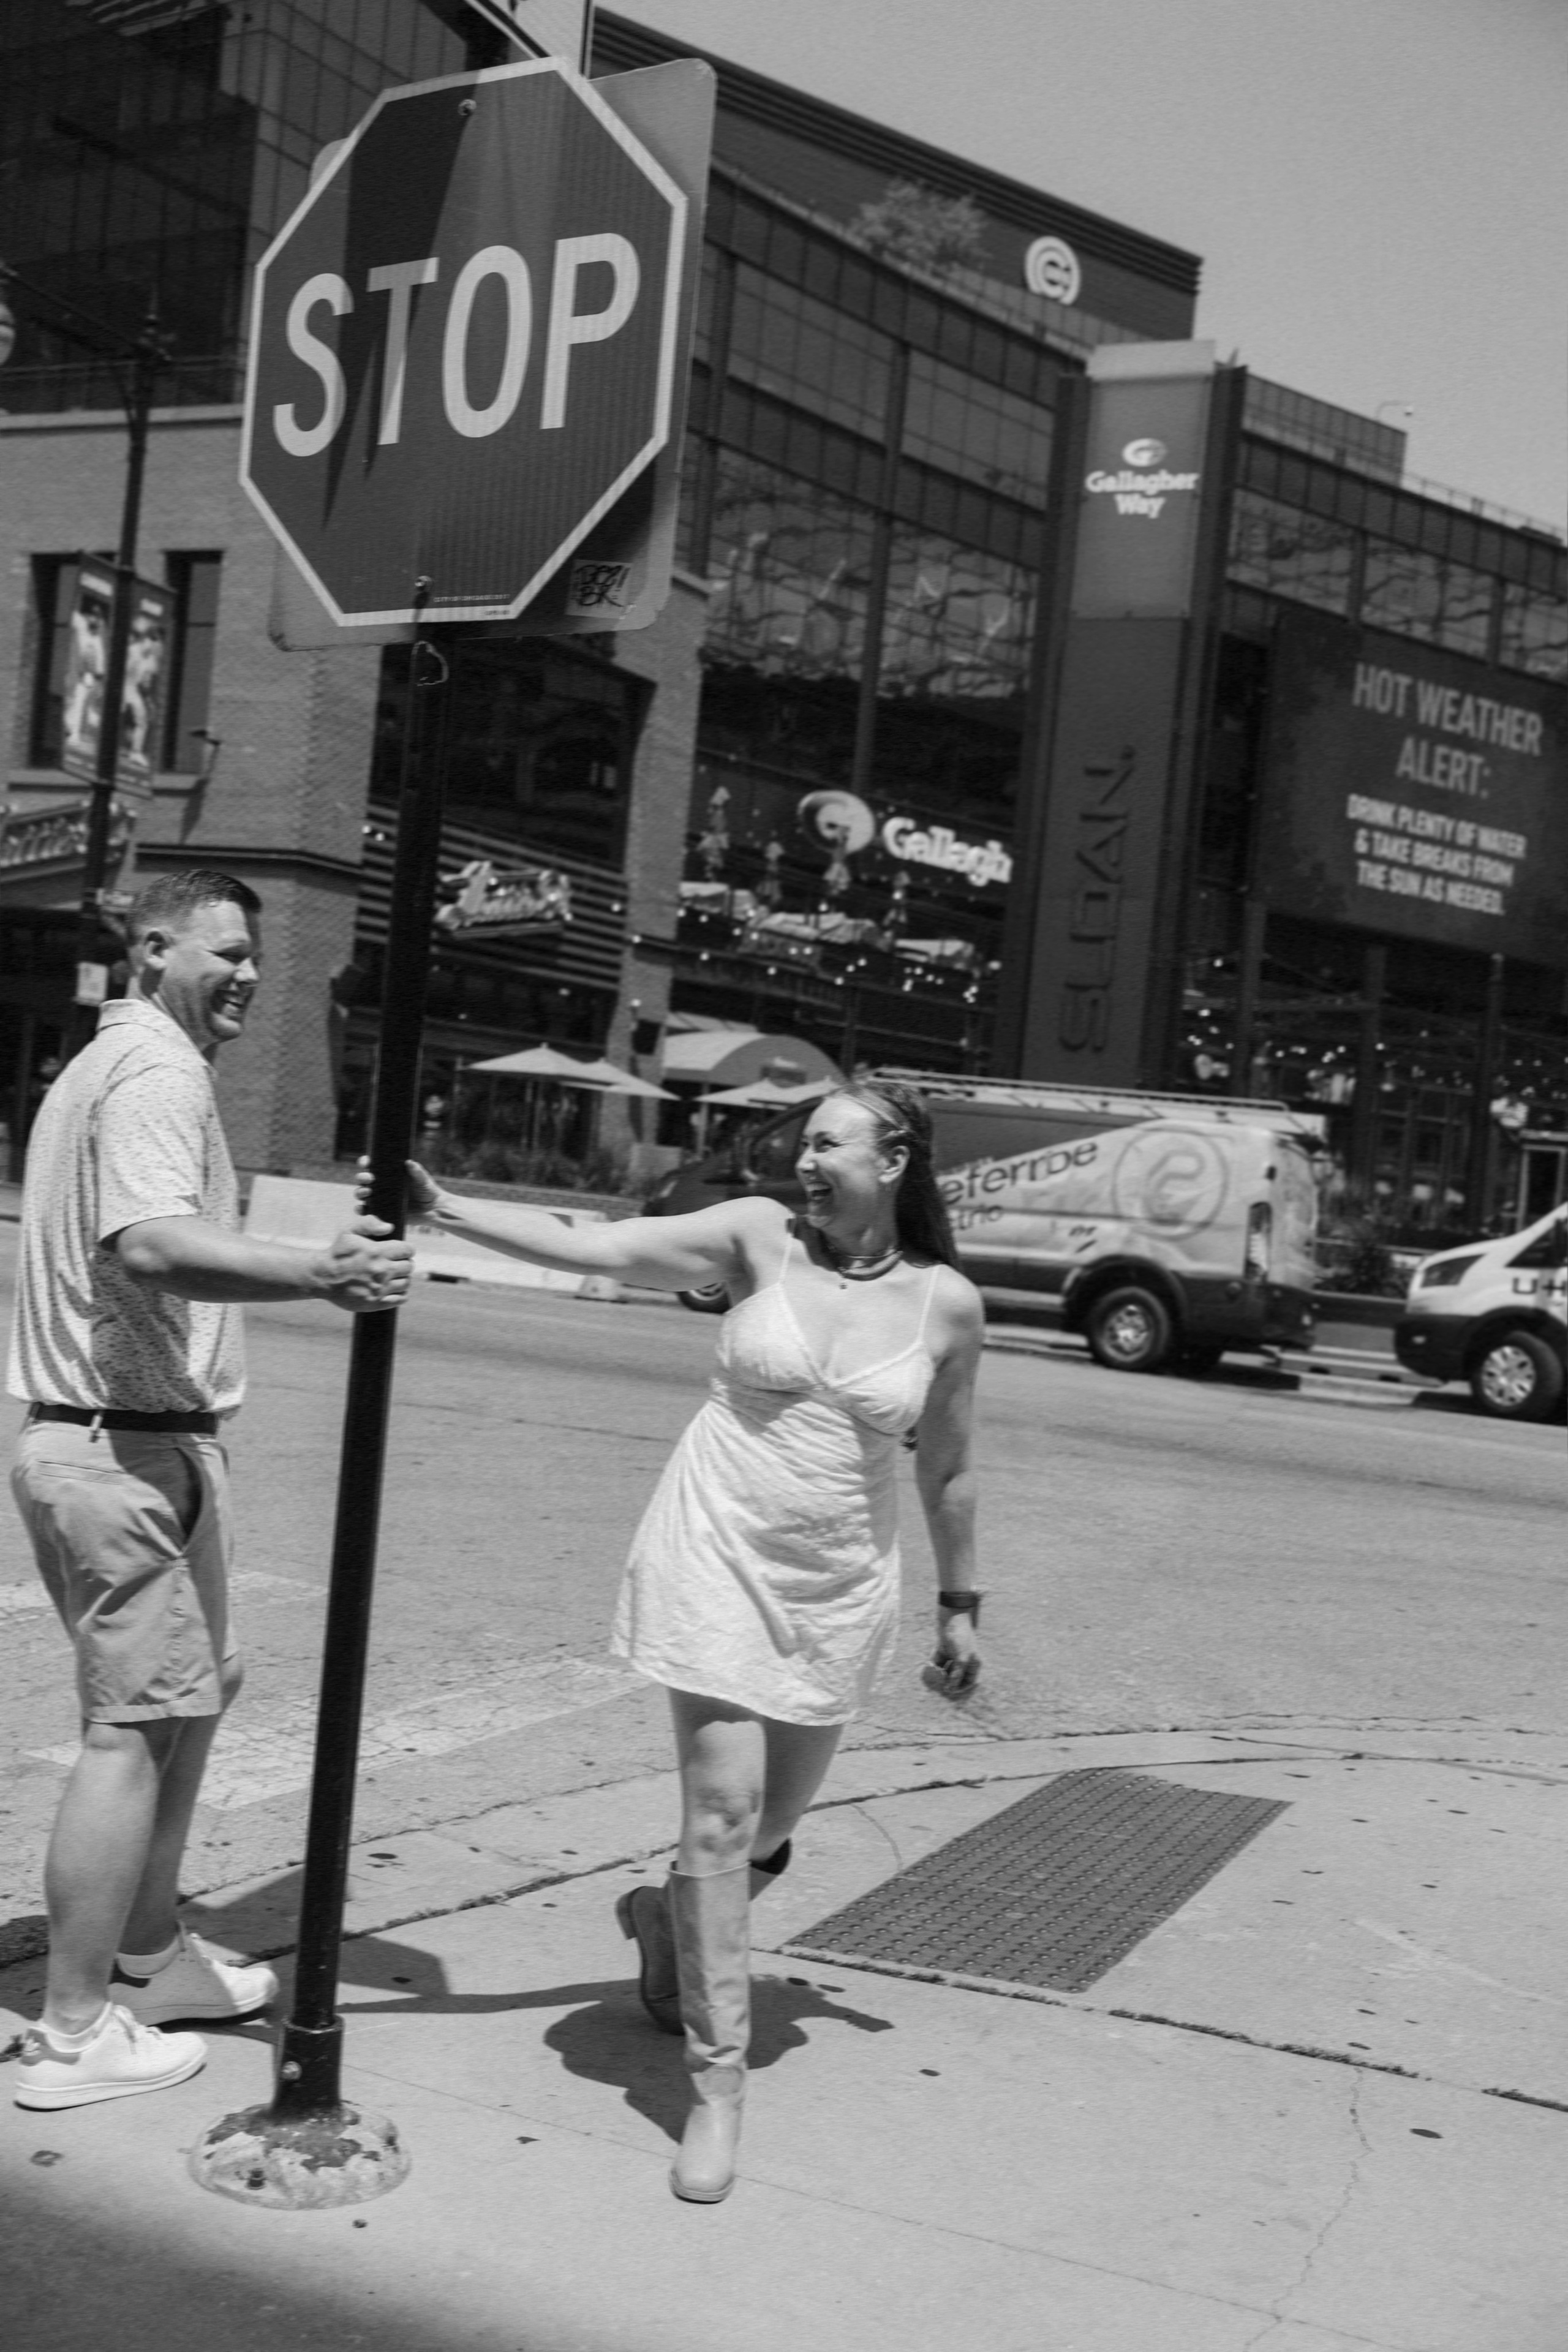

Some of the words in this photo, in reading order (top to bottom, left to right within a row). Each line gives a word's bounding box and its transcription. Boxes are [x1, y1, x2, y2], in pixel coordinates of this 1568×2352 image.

[273, 232, 641, 457] STOP
[1085, 469, 1201, 496] Gallagher
[1114, 494, 1166, 519] Way
[1352, 662, 1412, 718] HOT
[1417, 679, 1544, 756] WEATHER
[1396, 736, 1493, 799] ALERT:
[1346, 793, 1396, 829] DRINK
[1397, 807, 1455, 843] PLENTY
[1456, 821, 1477, 846] OF
[1477, 826, 1528, 860] WATER
[1354, 827, 1370, 854] &
[1372, 831, 1412, 864] TAKE
[1412, 840, 1471, 877] BREAKS
[1472, 855, 1515, 887] FROM
[1357, 859, 1388, 890] THE
[1389, 867, 1422, 896] SUN
[1423, 875, 1444, 902] AS
